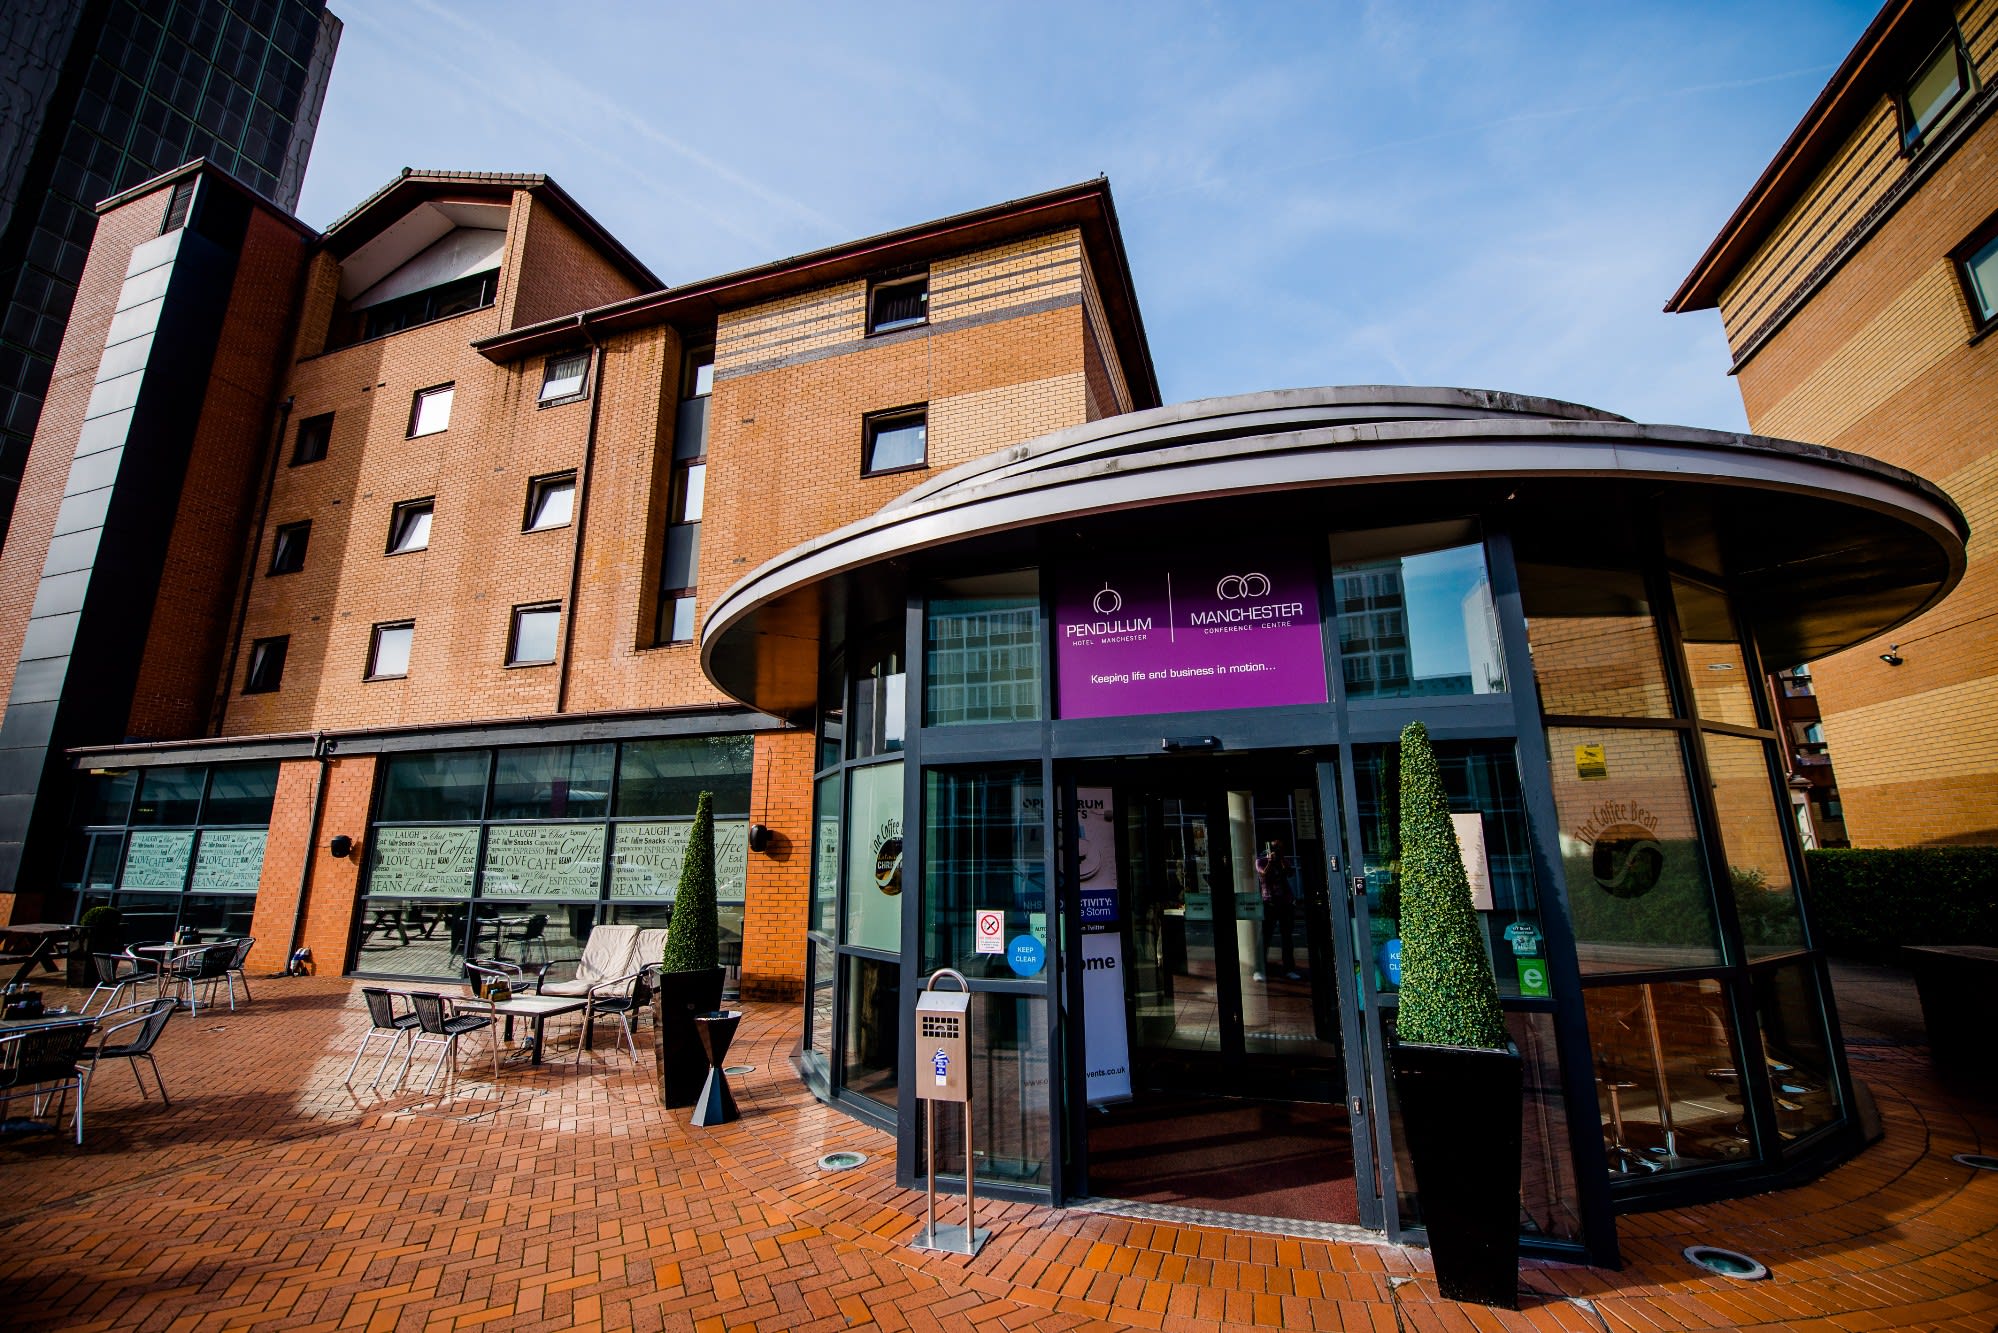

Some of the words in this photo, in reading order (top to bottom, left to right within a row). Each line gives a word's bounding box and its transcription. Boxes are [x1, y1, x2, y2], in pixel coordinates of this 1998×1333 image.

[1191, 602, 1303, 626] MANCHESTER
[1066, 617, 1152, 638] PENDULUM
[1204, 624, 1253, 634] CONFERENCE
[1261, 620, 1292, 629] CENTRE
[1101, 634, 1147, 644] MANCHESTER
[1091, 673, 1129, 684] Keeping
[1132, 671, 1146, 681] life
[1148, 669, 1167, 680] and
[1170, 666, 1214, 678] business
[1217, 664, 1226, 674] in
[1574, 819, 1599, 846] The
[1593, 800, 1627, 826] Coffee
[1632, 800, 1658, 832] Bean
[509, 829, 537, 837] LAUGH
[639, 827, 670, 836] LAUGH
[387, 856, 410, 865] LOVE
[410, 857, 437, 869] CAFE
[501, 855, 526, 866] LOVE
[527, 858, 557, 870] CAFE
[631, 855, 660, 866] LOVE
[728, 854, 743, 863] Eat
[579, 866, 600, 875] Laugh
[719, 865, 744, 877] Laugh
[371, 881, 403, 891] BEANS
[549, 877, 588, 885] ESPRESSO
[483, 882, 520, 894] BEANS
[611, 884, 653, 896] BEANS
[1086, 908, 1111, 916] Storm
[1087, 1066, 1126, 1078] vents.co.uk
